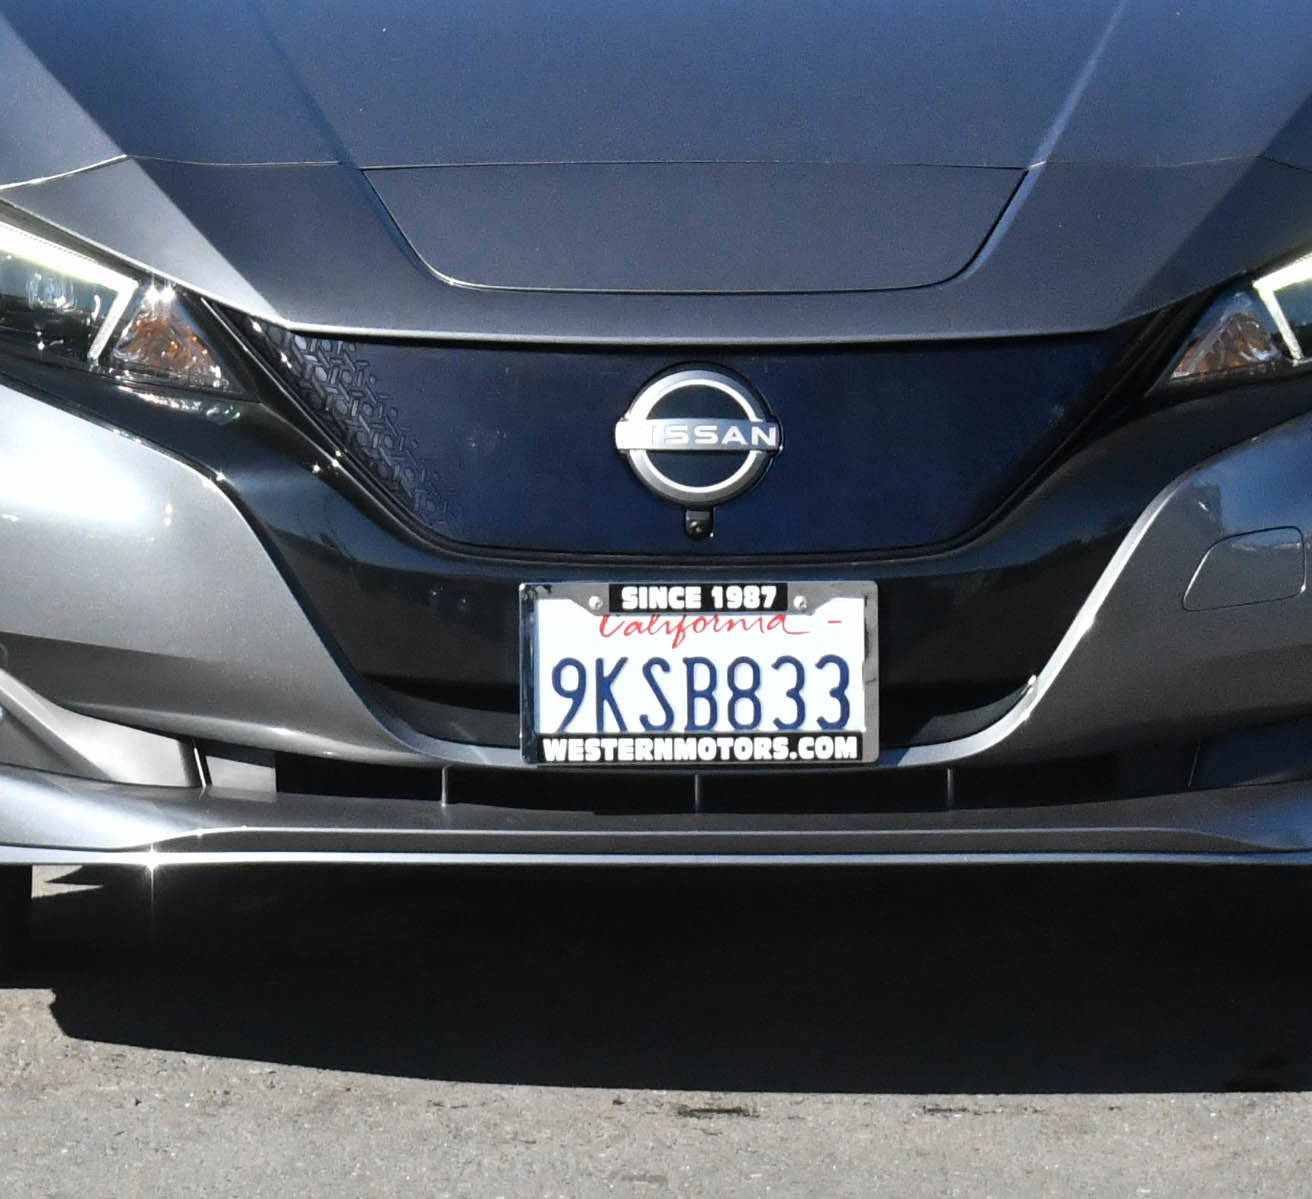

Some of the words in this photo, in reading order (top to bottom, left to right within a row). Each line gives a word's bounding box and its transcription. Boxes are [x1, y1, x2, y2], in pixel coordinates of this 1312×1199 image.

[621, 586, 702, 610] SINCE
[711, 585, 778, 609] 1987
[552, 654, 851, 732] 9KSB833
[542, 736, 858, 762] WESTERNMOTORS.COM
